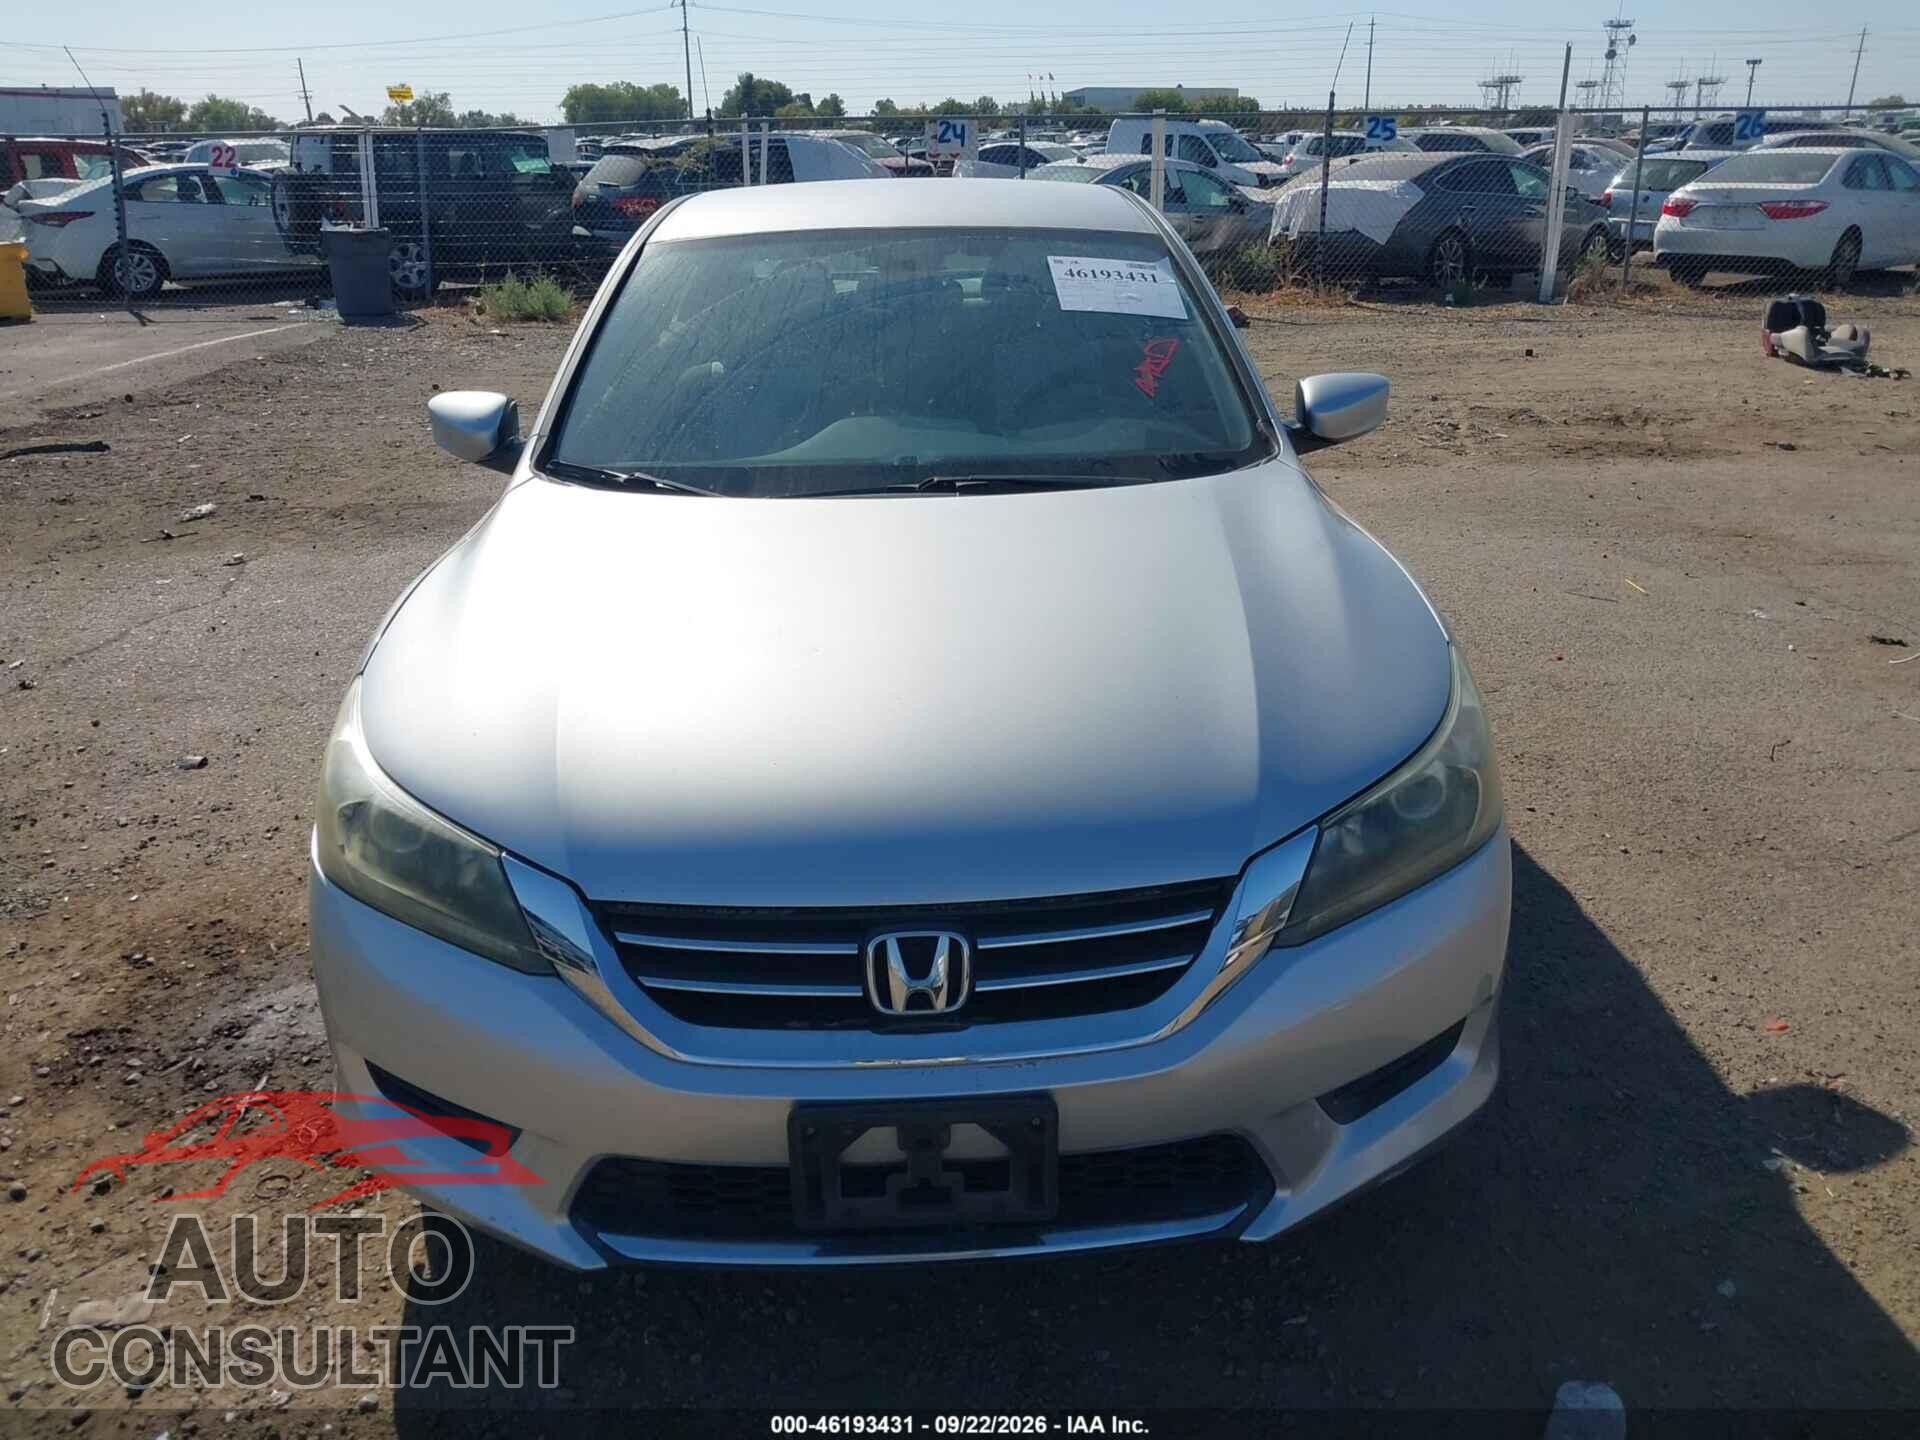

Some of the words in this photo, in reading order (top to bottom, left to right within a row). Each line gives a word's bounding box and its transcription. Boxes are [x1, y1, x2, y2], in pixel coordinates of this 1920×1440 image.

[938, 120, 966, 148] 24
[1366, 116, 1396, 141] 25
[1736, 113, 1765, 140] 26
[211, 145, 237, 169] 22
[1063, 267, 1159, 284] 46193431
